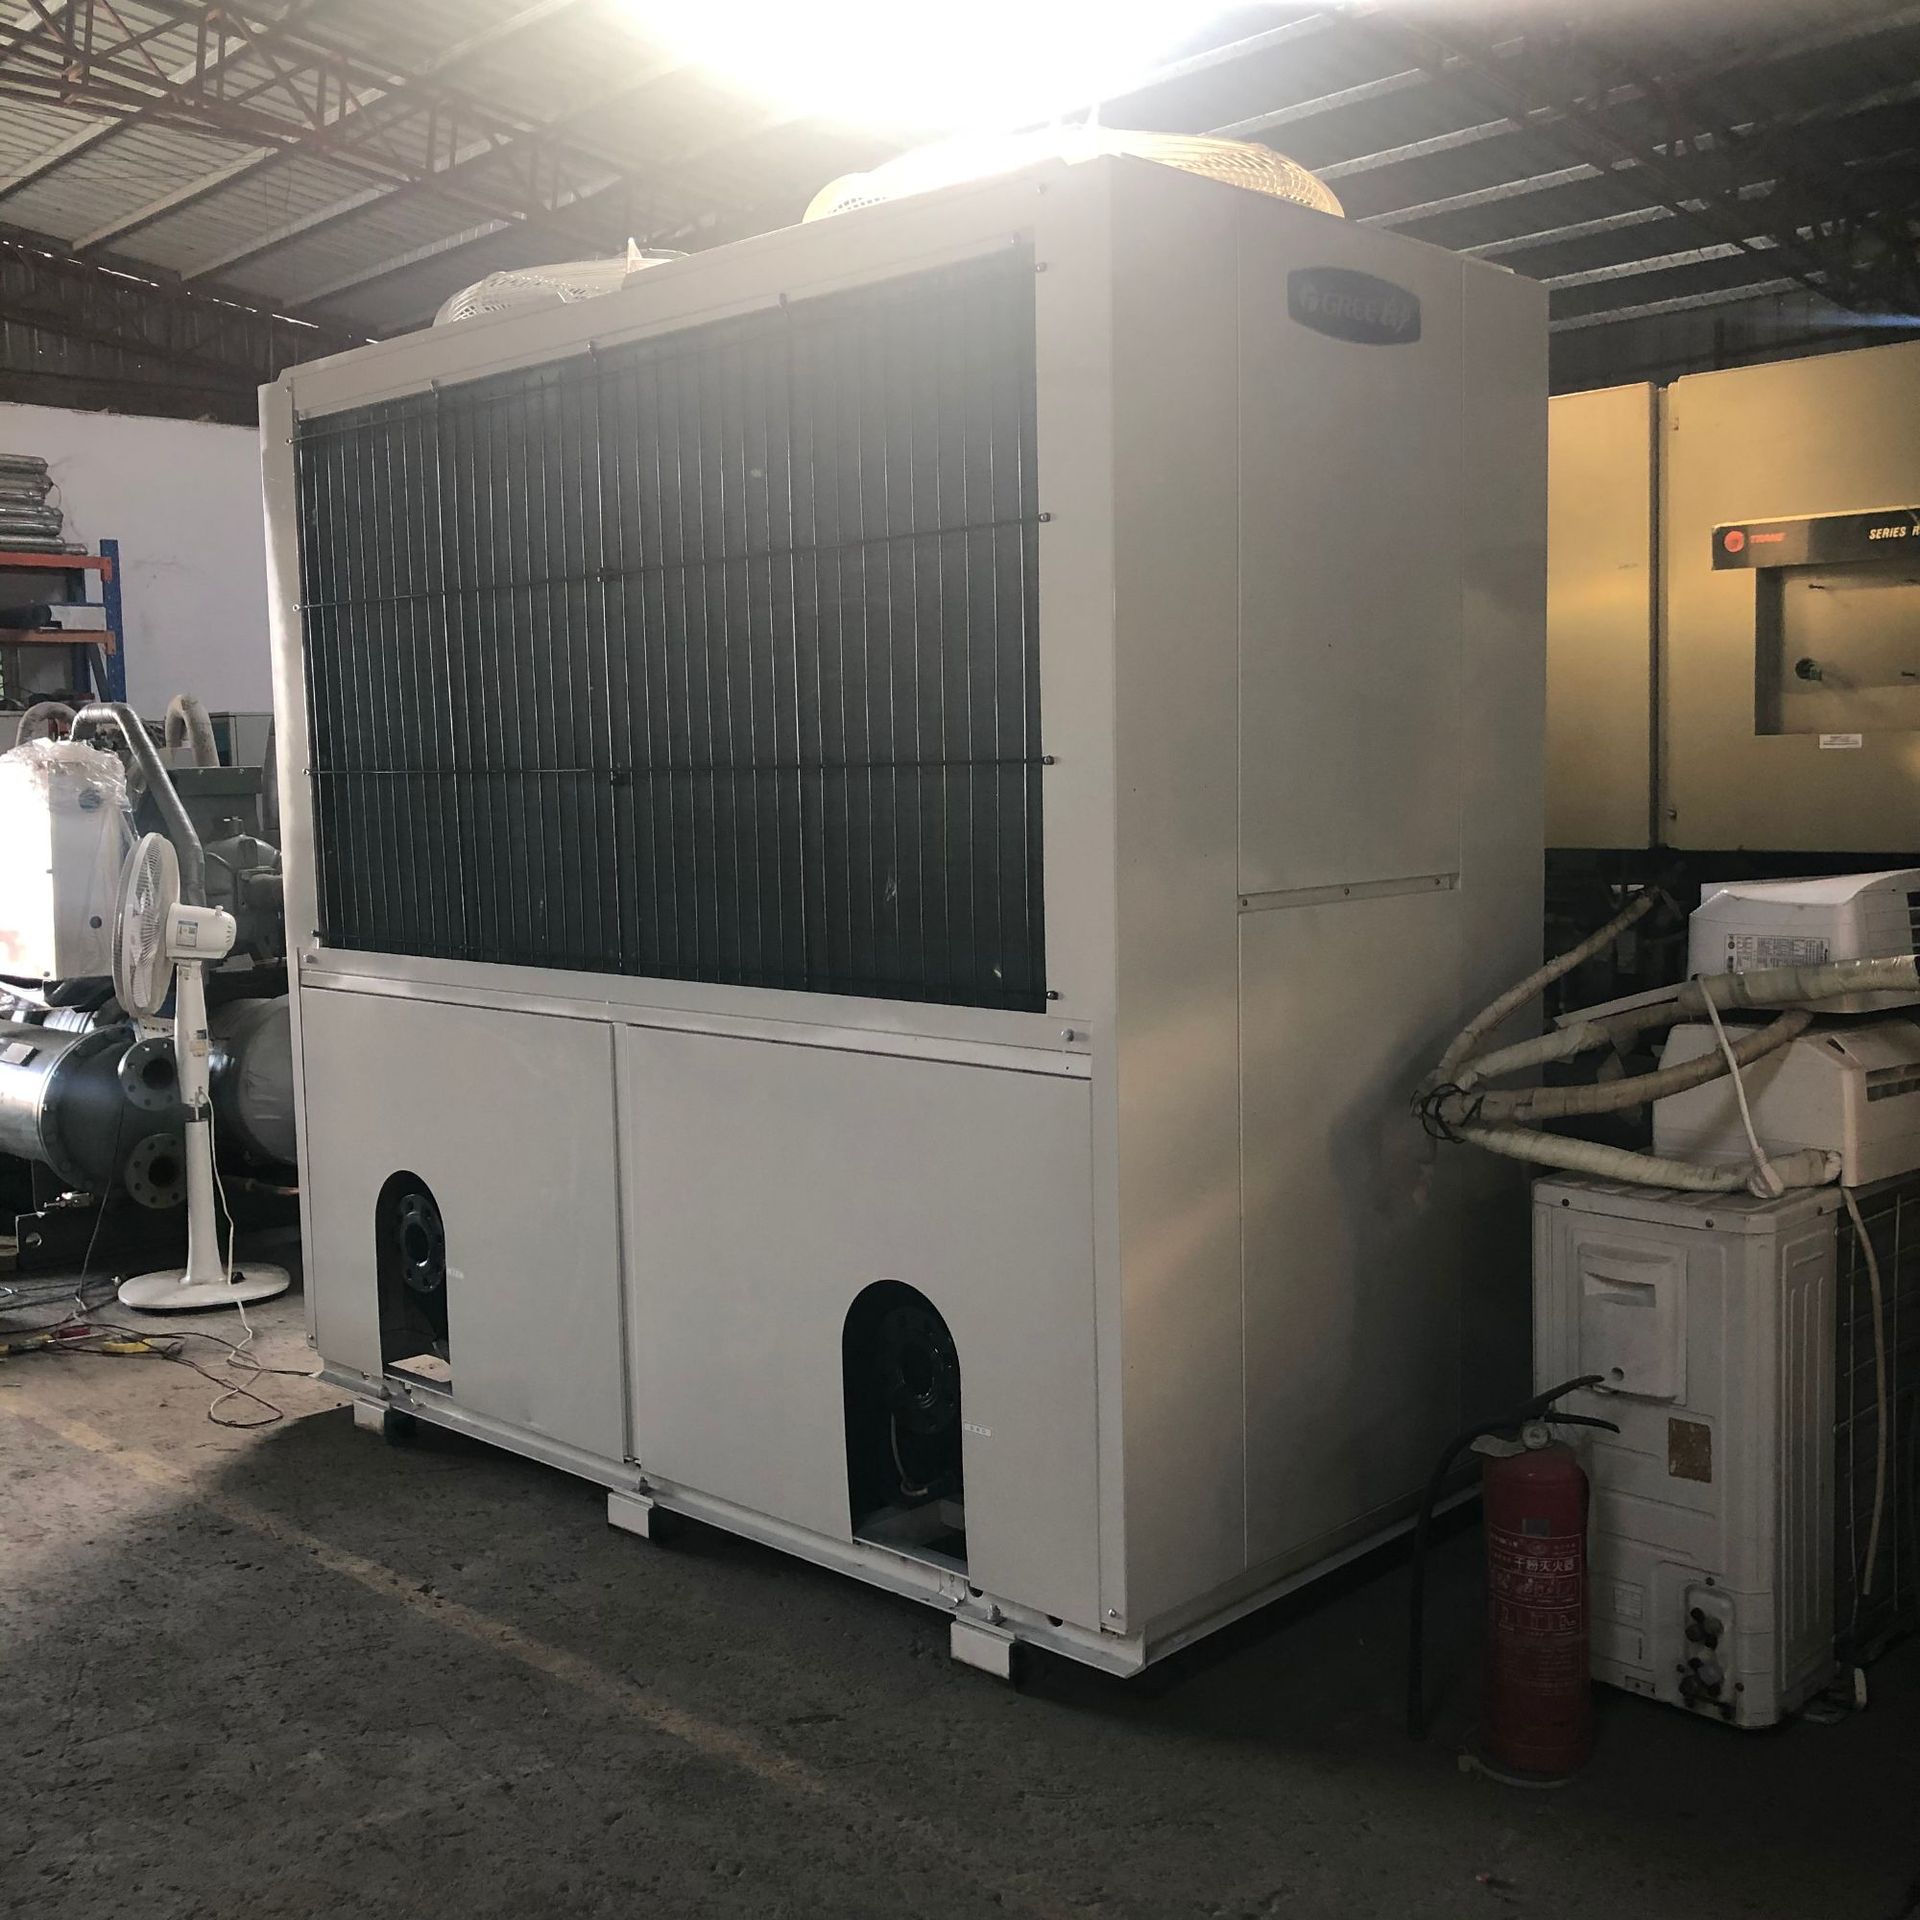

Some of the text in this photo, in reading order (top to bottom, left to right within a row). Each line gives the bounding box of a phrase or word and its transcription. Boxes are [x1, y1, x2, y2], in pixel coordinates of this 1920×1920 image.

[1321, 293, 1376, 322] GREE
[1868, 526, 1907, 540] SERIES
[1514, 1556, 1574, 1572] 干粉灭火器
